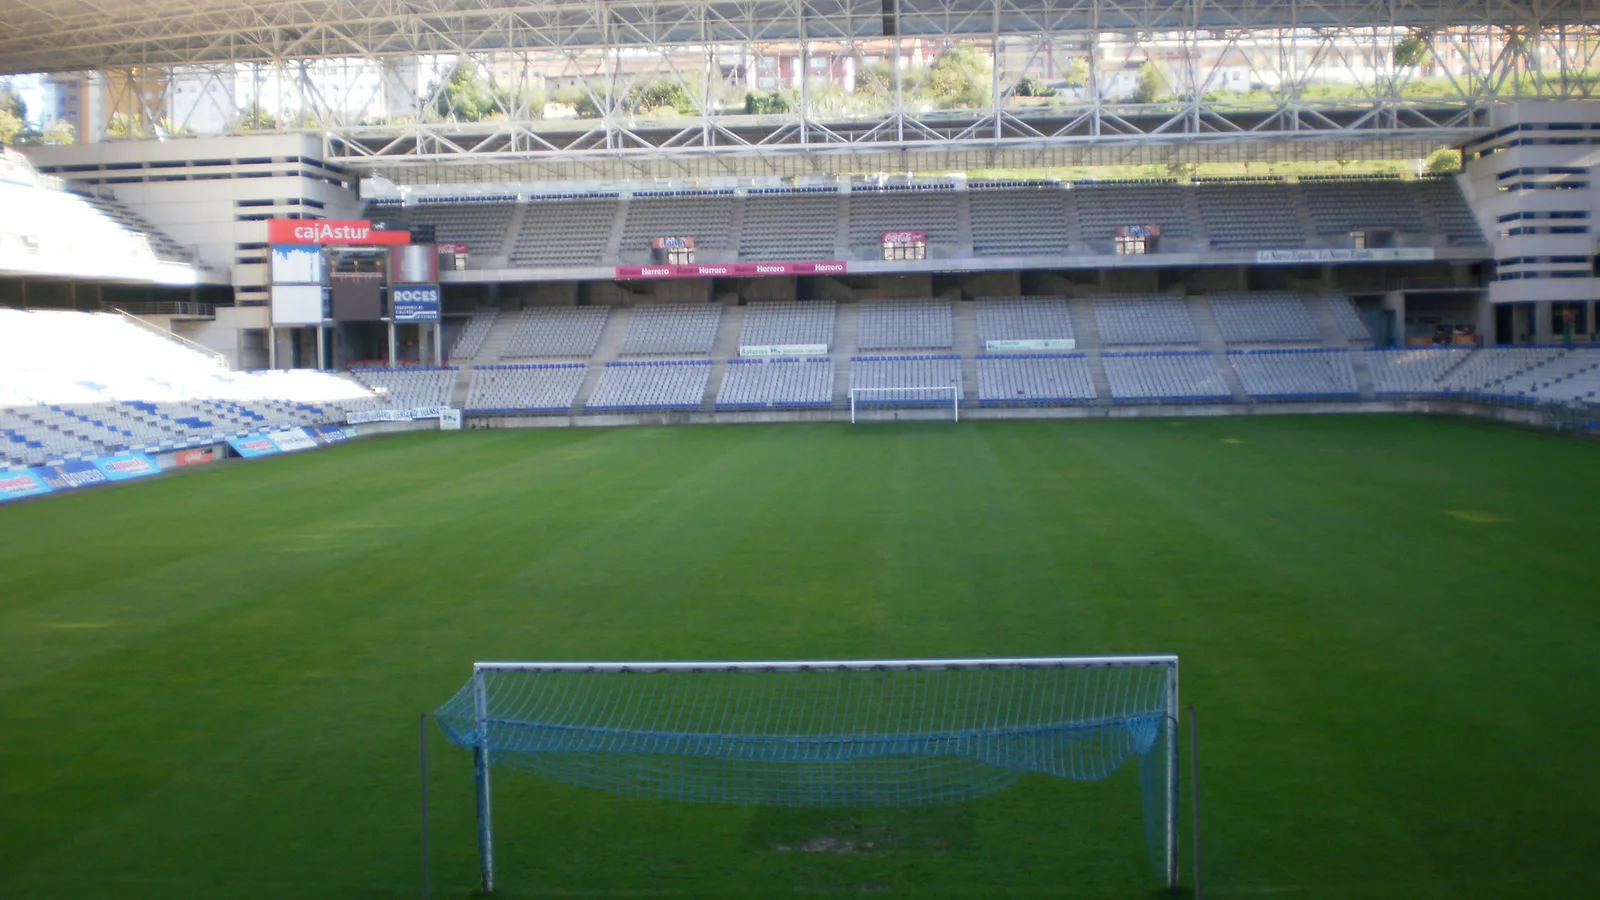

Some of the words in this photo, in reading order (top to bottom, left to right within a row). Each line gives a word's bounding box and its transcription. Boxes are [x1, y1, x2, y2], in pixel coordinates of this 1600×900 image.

[294, 224, 370, 242] cajAstur
[641, 267, 669, 275] Herrero
[699, 266, 727, 274] Herrero
[394, 290, 438, 302] ROCES
